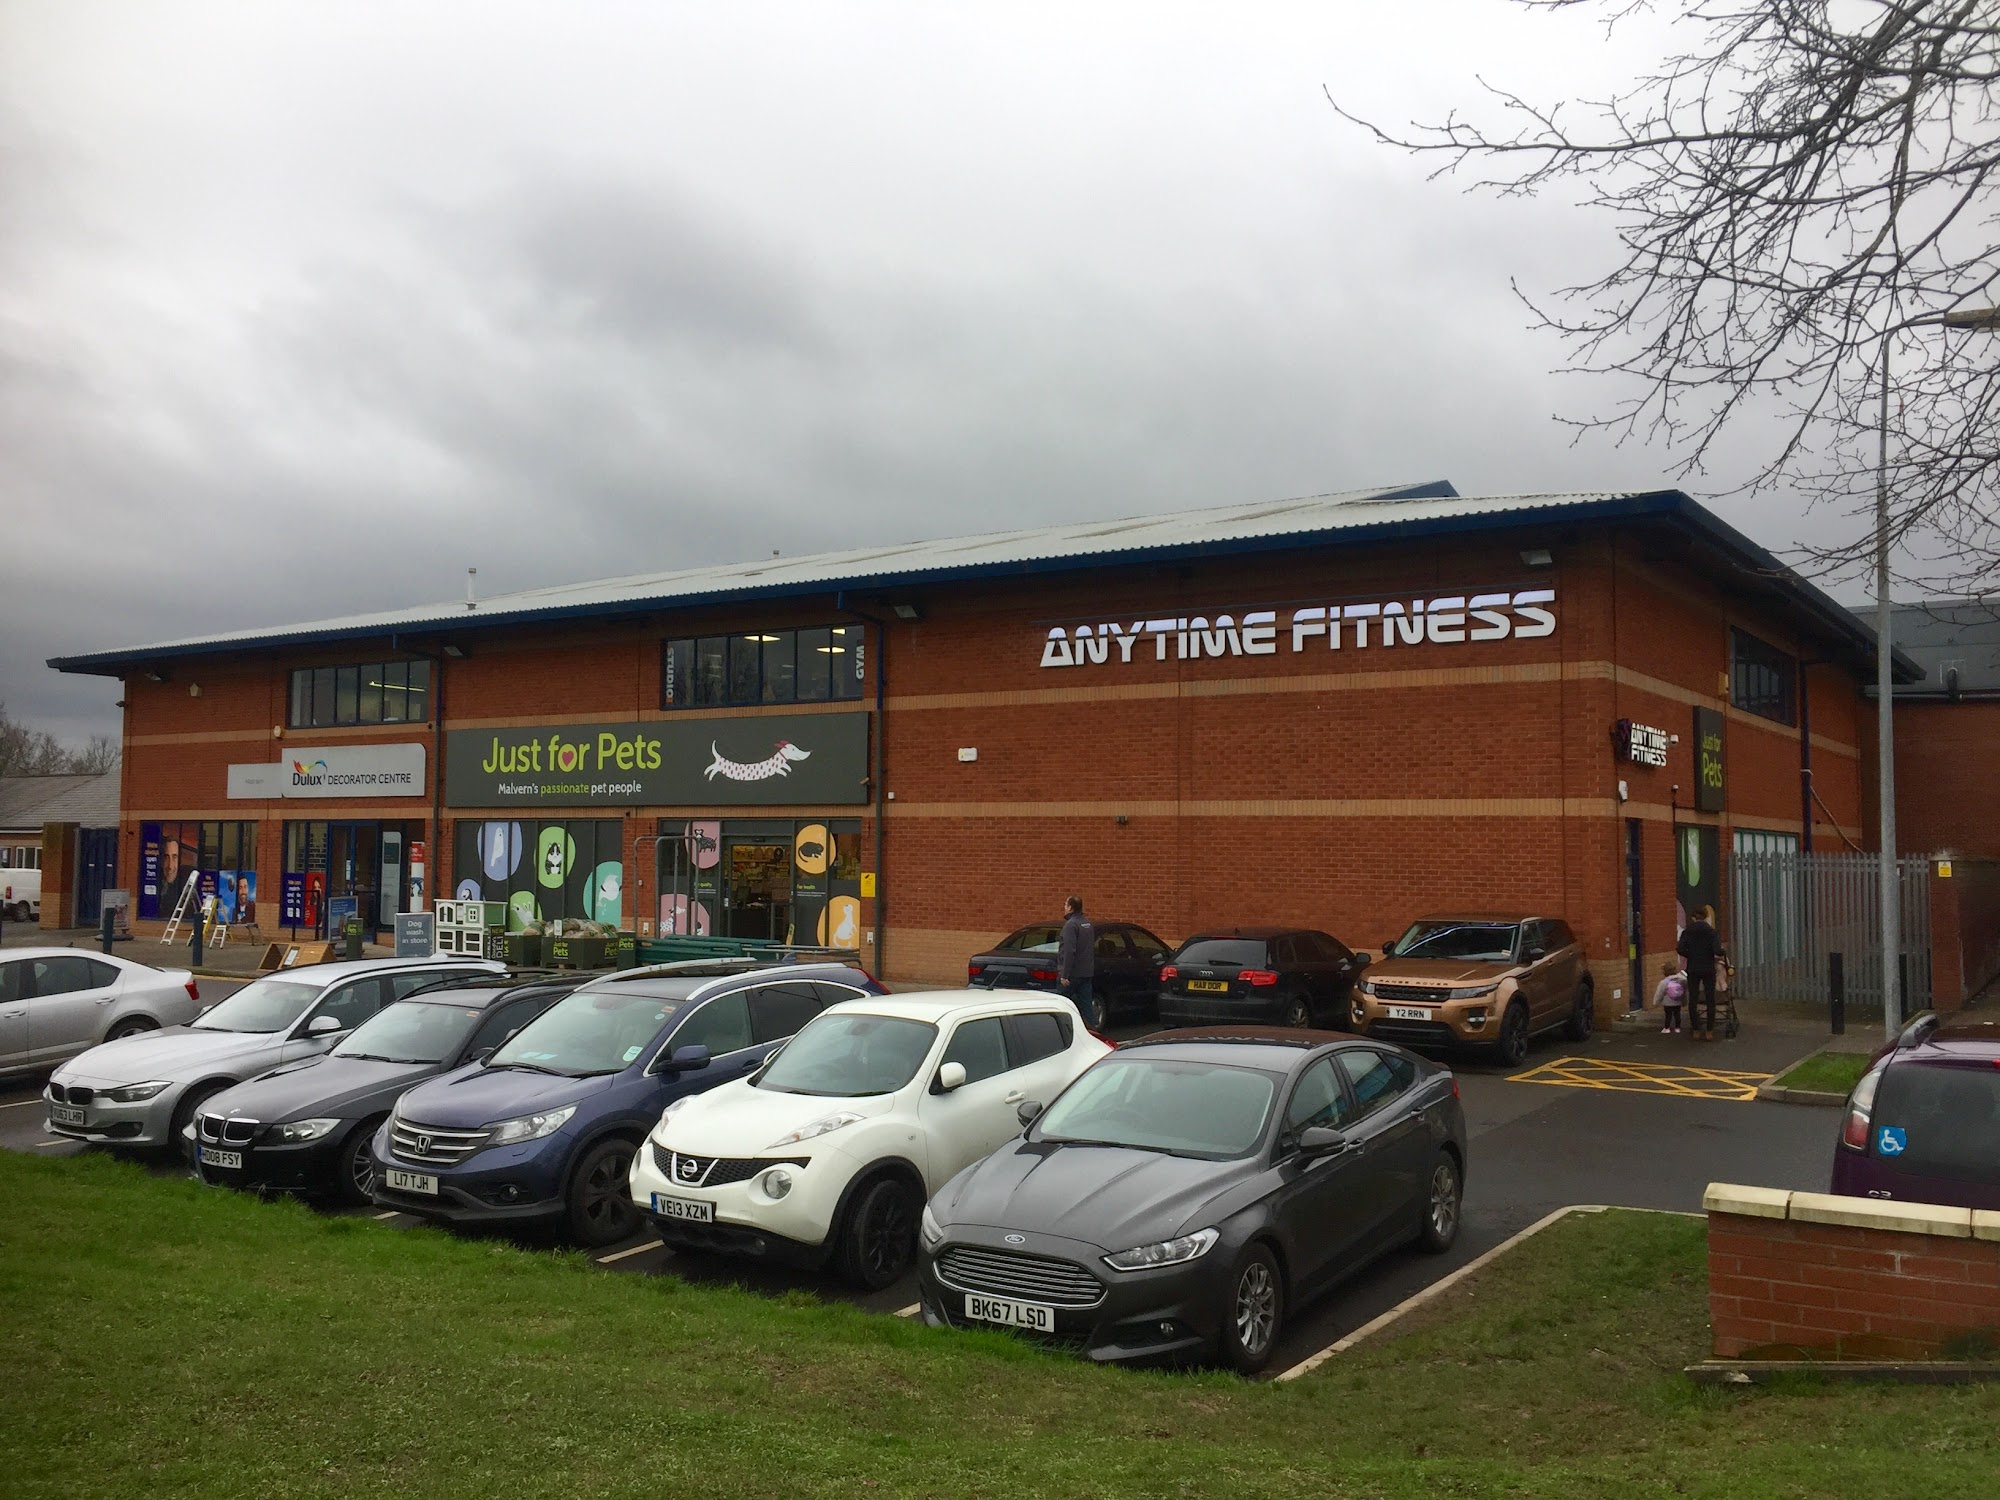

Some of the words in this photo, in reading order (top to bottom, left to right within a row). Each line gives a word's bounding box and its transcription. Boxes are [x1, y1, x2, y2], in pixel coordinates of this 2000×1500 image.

[1040, 611, 1277, 668] ANYTIME
[1291, 589, 1556, 652] FITNESS
[666, 647, 675, 698] STUDIO
[855, 644, 865, 680] GYM
[1630, 722, 1667, 750] ANYTIME
[482, 737, 542, 774] Just
[548, 734, 591, 773] for
[597, 732, 662, 770] Pets
[1630, 743, 1667, 767] FITNESS
[292, 772, 322, 786] Dulux
[327, 774, 377, 786] DECORATOR
[378, 773, 412, 784] CENTRE
[1702, 751, 1723, 788] Pets
[498, 782, 539, 796] Malvern's
[540, 781, 589, 797] passionate
[591, 782, 607, 797] pet
[608, 780, 642, 797] people
[407, 920, 423, 928] Dog
[553, 947, 569, 957] Pets
[1396, 1008, 1406, 1017] Y2
[1407, 1009, 1424, 1019] RRN
[68, 1110, 82, 1123] LHR
[221, 1152, 240, 1166] FSY
[410, 1175, 430, 1190] TJH
[659, 1197, 683, 1214] VE13
[685, 1201, 709, 1220] XZM
[971, 1297, 1011, 1321] BK67
[1015, 1305, 1047, 1327] LSD
